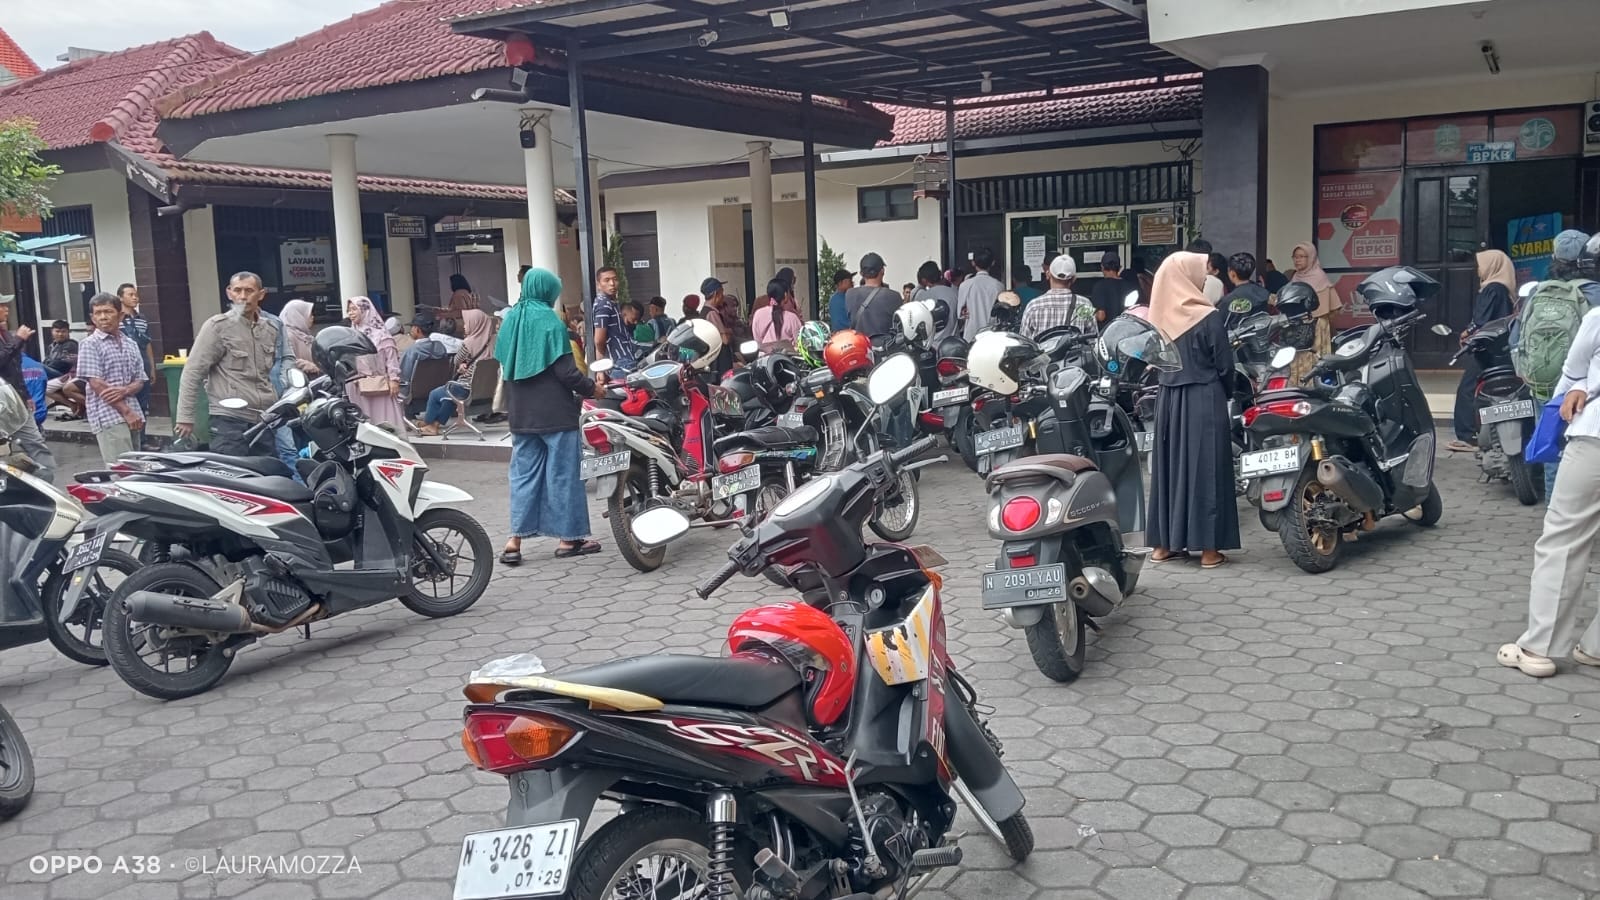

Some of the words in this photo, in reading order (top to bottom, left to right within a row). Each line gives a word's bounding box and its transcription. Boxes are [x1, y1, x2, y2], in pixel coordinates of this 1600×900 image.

[1472, 151, 1512, 162] BPKB
[1071, 223, 1117, 232] LAYANAN
[1063, 231, 1088, 242] CEK
[1091, 230, 1125, 241] FISIK
[1356, 245, 1393, 255] BPKB
[288, 257, 325, 265] LAYANAN
[1244, 455, 1250, 467] L
[1258, 451, 1280, 464] 4012
[986, 577, 994, 589] N
[1004, 572, 1032, 588] 2091
[1037, 569, 1060, 584] YAU
[462, 839, 475, 867] N
[489, 832, 534, 862] 3426
[545, 828, 569, 856] ZI
